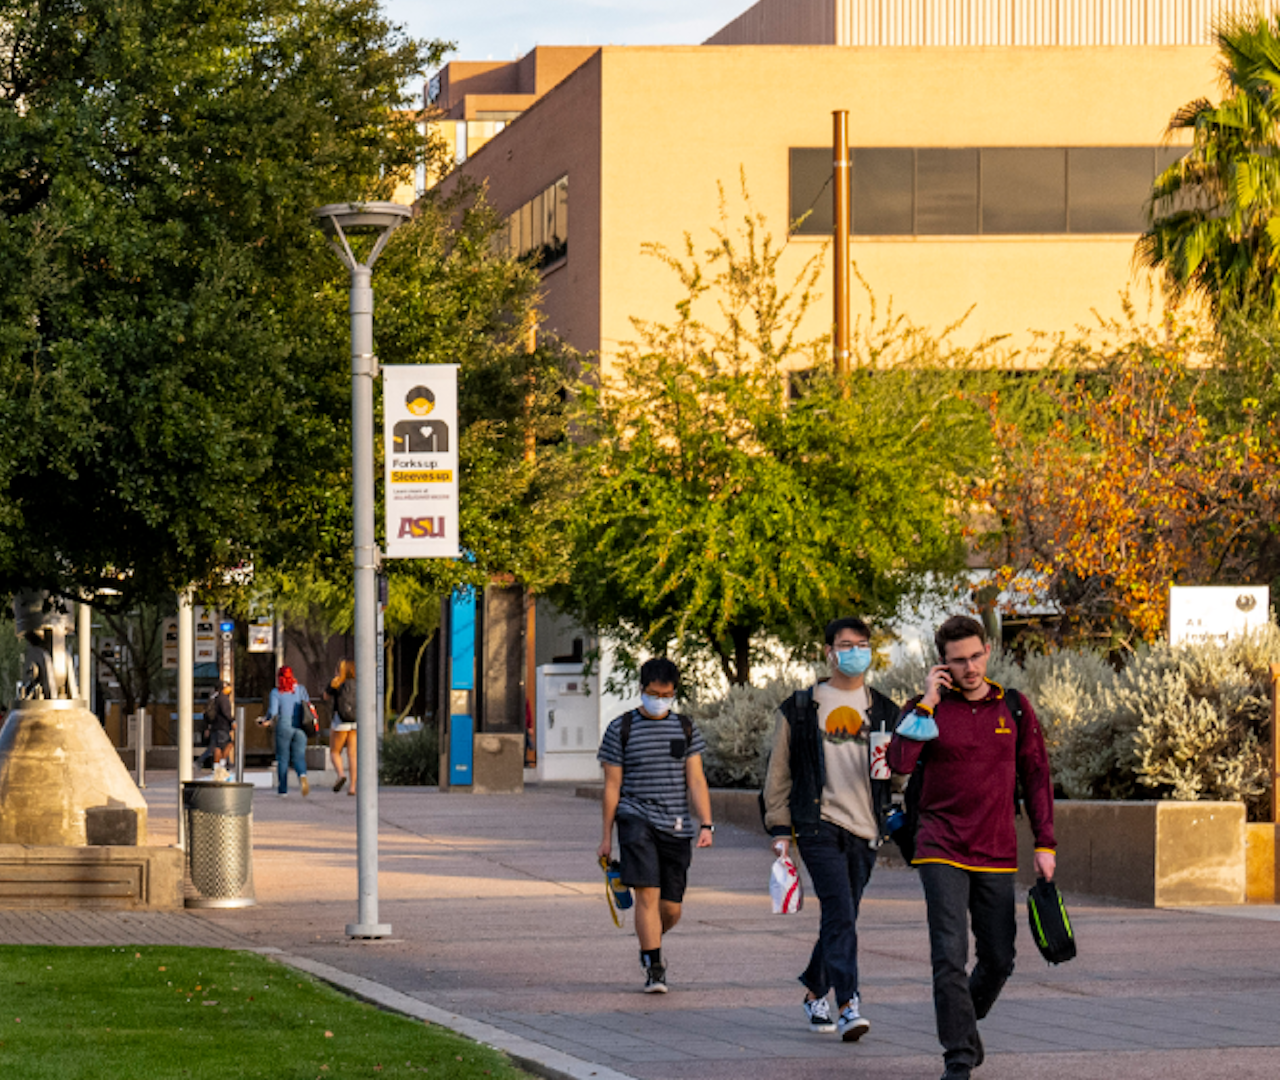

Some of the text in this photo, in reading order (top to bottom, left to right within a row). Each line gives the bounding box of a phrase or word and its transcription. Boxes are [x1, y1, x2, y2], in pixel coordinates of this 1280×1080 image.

[392, 458, 422, 468] Forks
[392, 471, 435, 482] Sleeves
[397, 516, 446, 539] ASU
